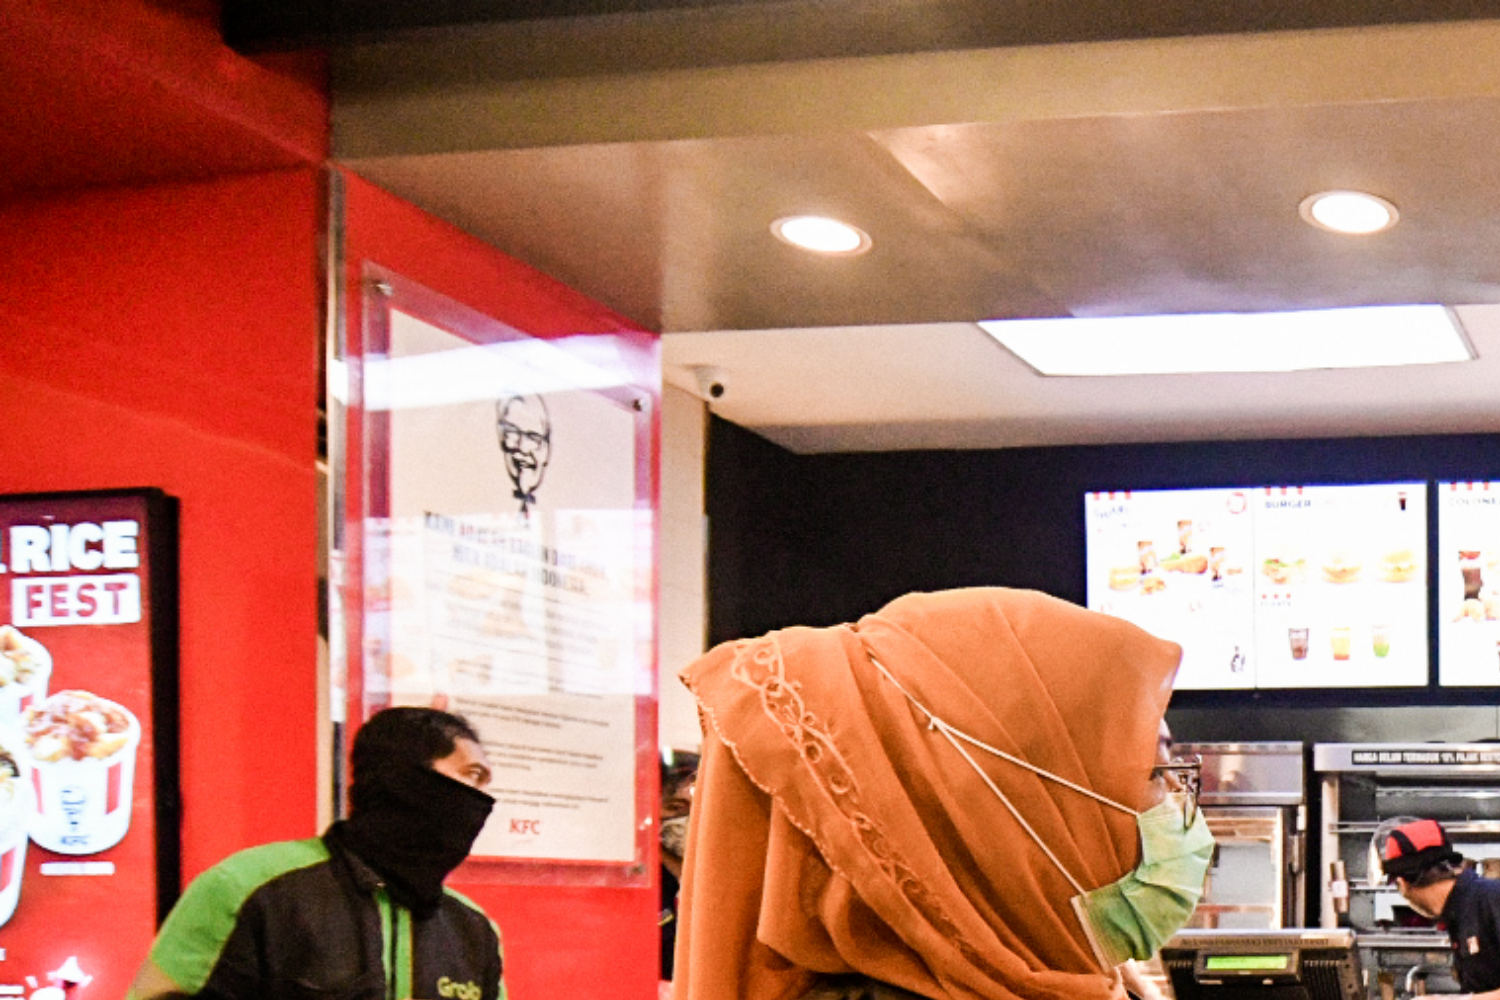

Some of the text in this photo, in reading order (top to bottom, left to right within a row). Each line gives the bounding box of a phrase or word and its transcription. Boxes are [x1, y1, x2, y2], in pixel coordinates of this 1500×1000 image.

[9, 519, 140, 574] RICE
[26, 581, 128, 620] FEST
[508, 818, 541, 836] KFC
